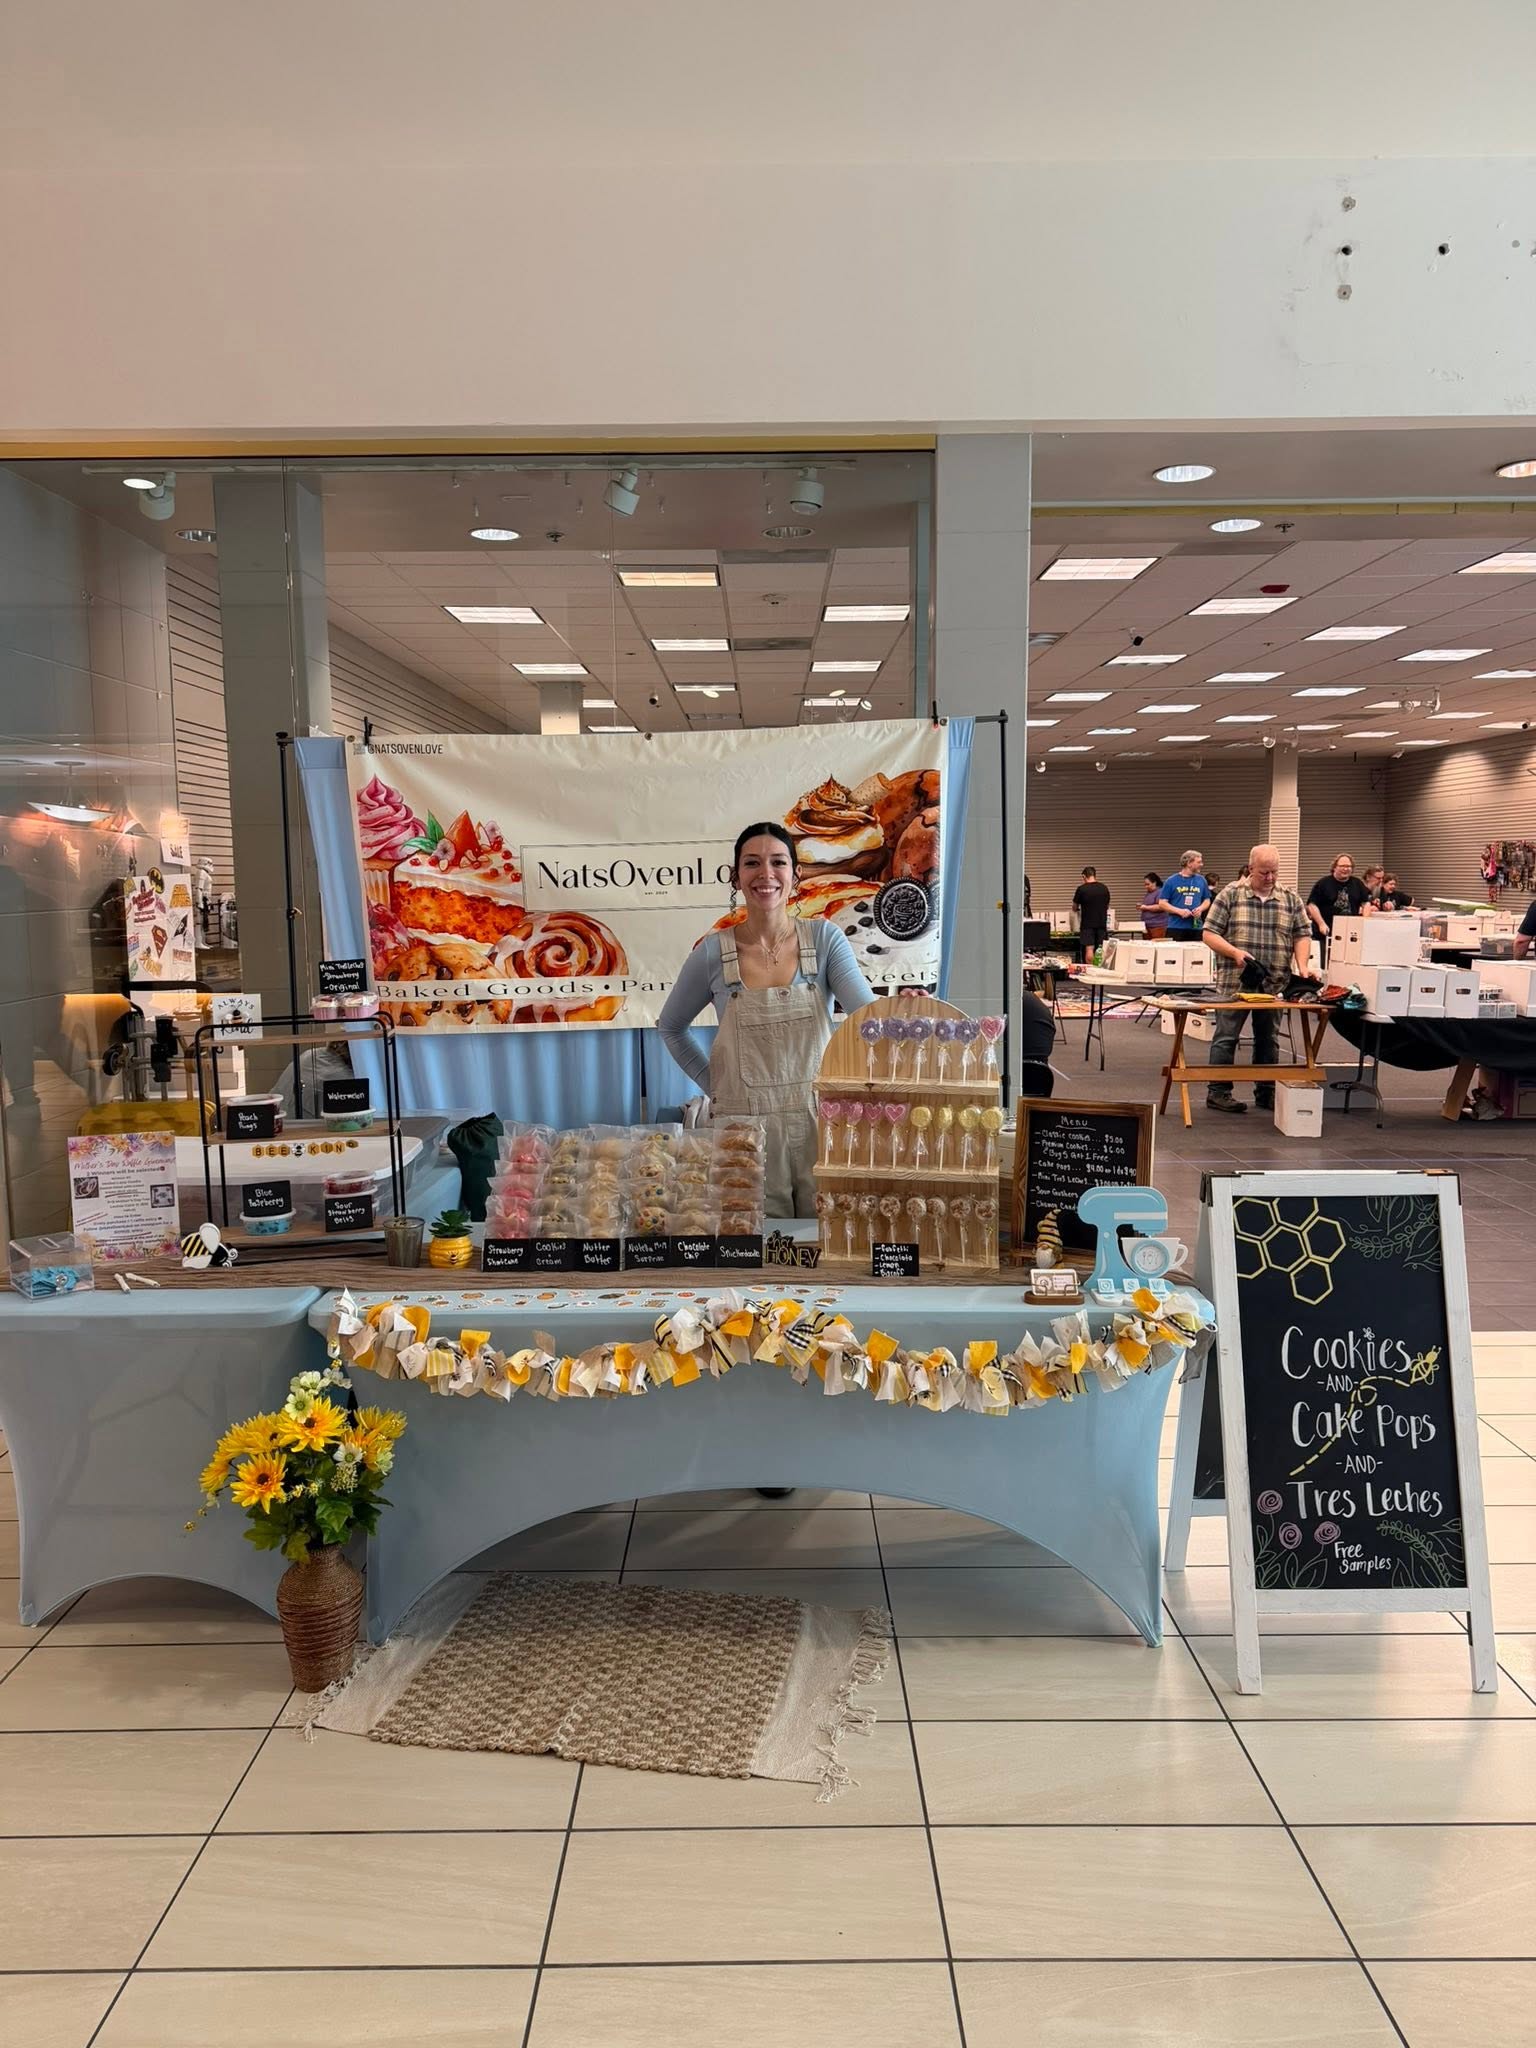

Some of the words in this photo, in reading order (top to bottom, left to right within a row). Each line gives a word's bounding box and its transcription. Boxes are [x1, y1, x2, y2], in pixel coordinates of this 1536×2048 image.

[537, 857, 732, 890] NatsOvenLo
[376, 983, 471, 1000] Baked
[487, 981, 594, 996] Goods
[621, 979, 673, 993] Par
[216, 998, 255, 1011] ALWAYS
[327, 1091, 366, 1101] Watermelon
[1060, 1115, 1089, 1127] Menu
[254, 1147, 288, 1157] BEE
[254, 1188, 274, 1198] Blue
[327, 1207, 366, 1216] Strawberry
[334, 1201, 352, 1210] Sour
[1059, 1201, 1078, 1211] Cand
[487, 1244, 524, 1257] Strawberry
[677, 1241, 711, 1252] Chocolate
[535, 1258, 562, 1266] Cream
[766, 1245, 819, 1269] HONEY
[1281, 1325, 1412, 1380] Cookies
[1291, 1401, 1365, 1448] Cake
[1376, 1404, 1436, 1450] Pops
[1285, 1480, 1357, 1520] Tres
[1365, 1481, 1444, 1518] Leches
[1334, 1541, 1365, 1559] Free
[1338, 1555, 1393, 1576] Samples
